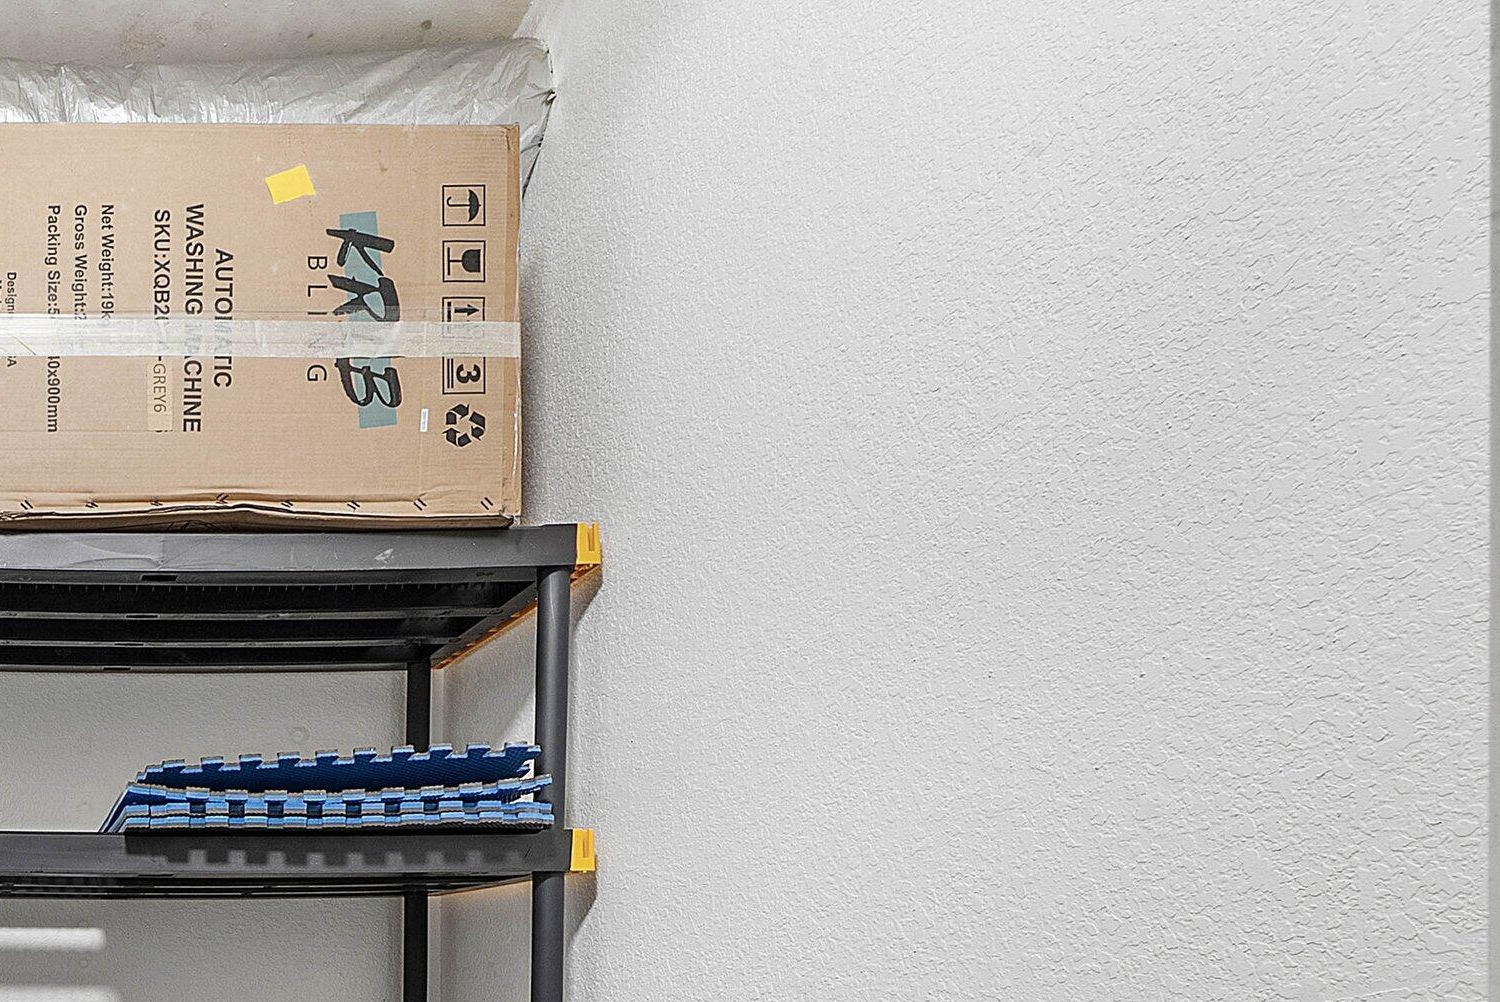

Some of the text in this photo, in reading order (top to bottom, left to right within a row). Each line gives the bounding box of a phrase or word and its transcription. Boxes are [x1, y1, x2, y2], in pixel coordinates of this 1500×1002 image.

[44, 204, 61, 265] Packing
[74, 204, 88, 251] Gross
[99, 204, 115, 321] Net Weight:19k
[184, 203, 205, 315] WASHING
[4, 271, 17, 314] Design
[326, 228, 402, 407] KRB
[456, 364, 481, 384] 3
